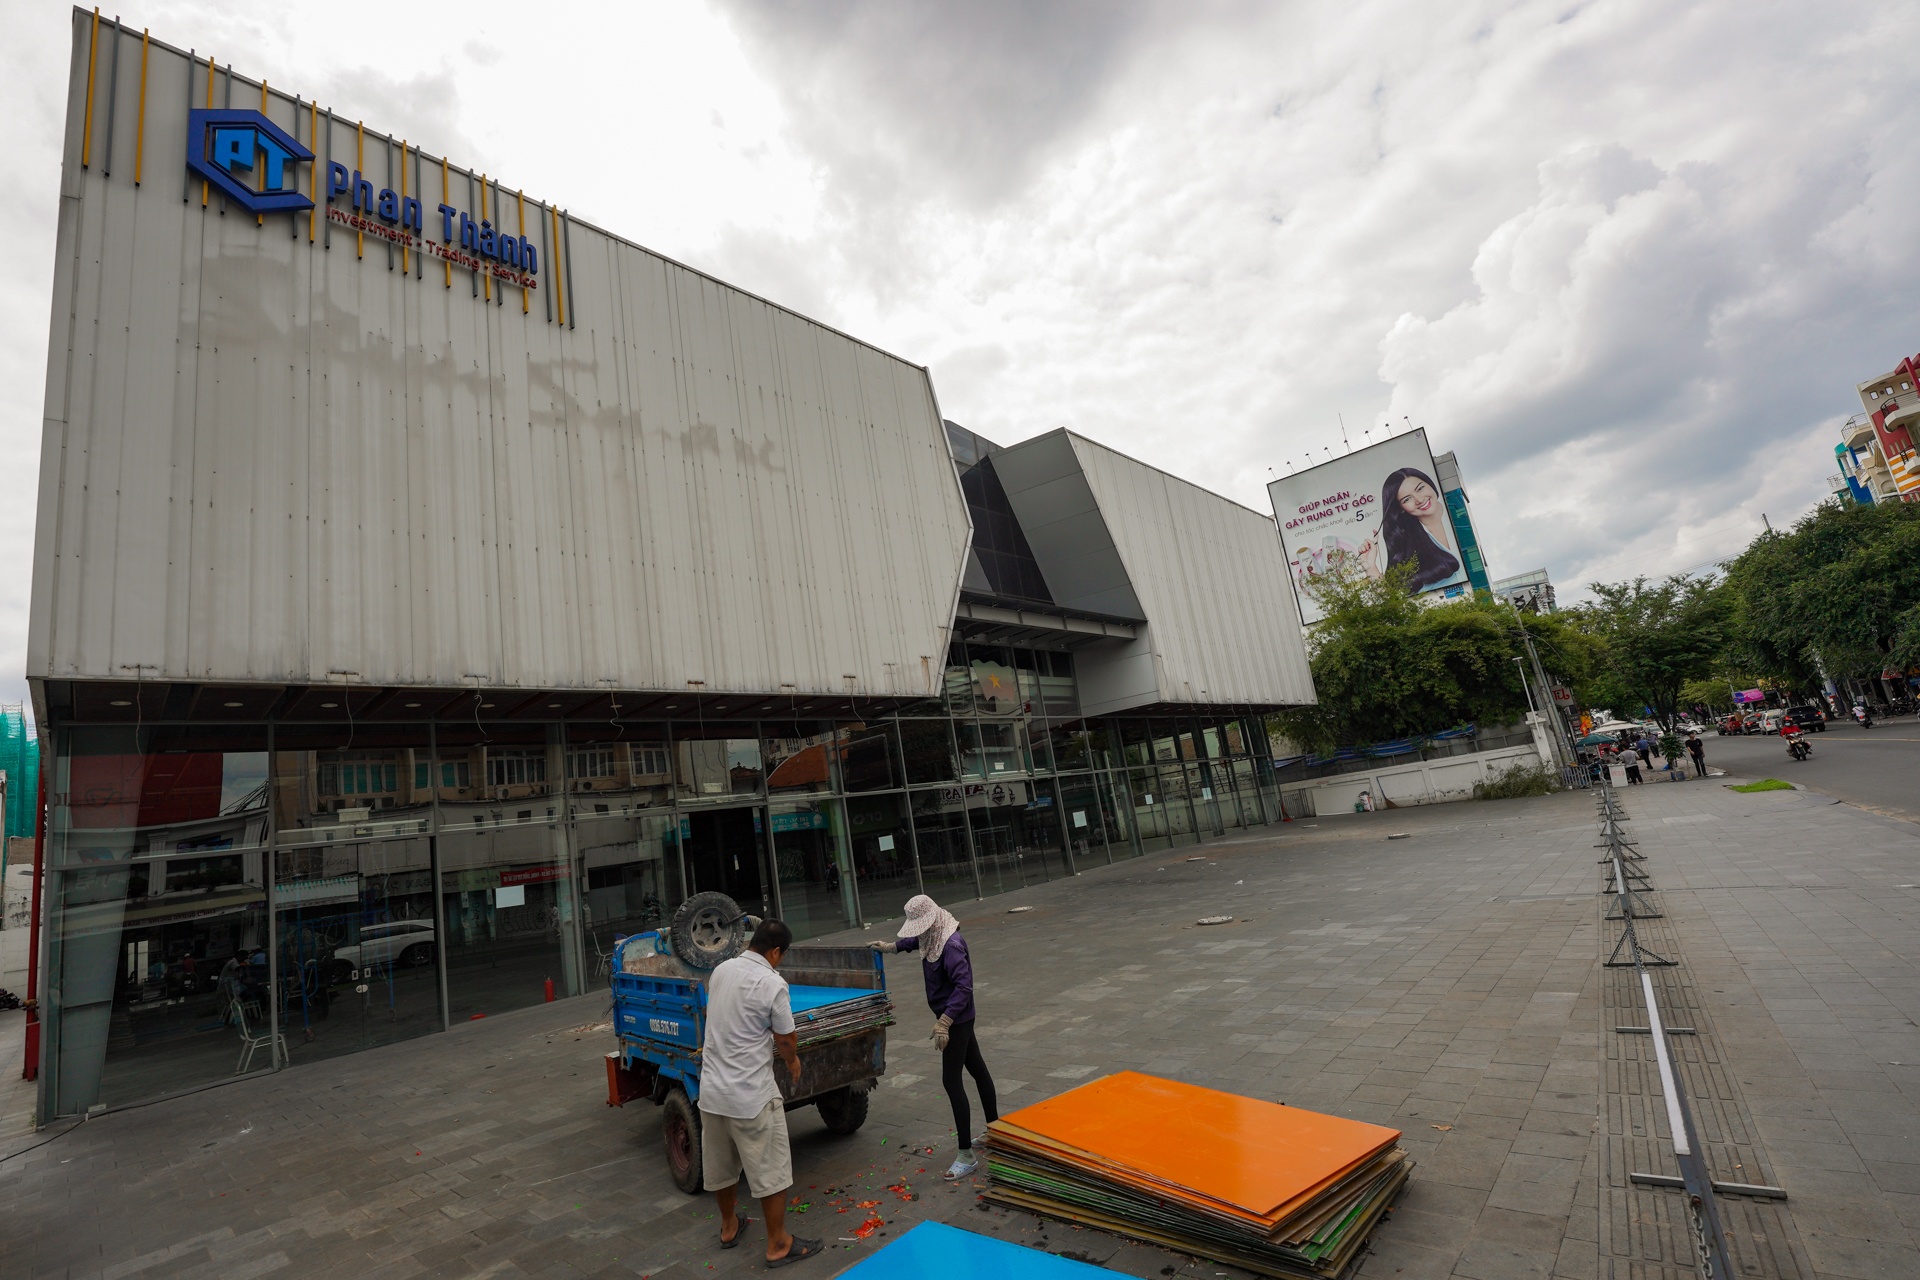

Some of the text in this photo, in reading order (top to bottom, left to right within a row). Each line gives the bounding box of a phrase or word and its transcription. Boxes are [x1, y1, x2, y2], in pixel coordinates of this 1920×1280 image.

[213, 128, 296, 191] PT
[327, 160, 539, 276] Phan Thành
[326, 205, 413, 246] Investment
[425, 239, 480, 273] Trading
[492, 263, 538, 290] Service
[1298, 491, 1350, 513] GIÚP NGĂN
[1307, 508, 1333, 522] RỤNG
[1335, 503, 1349, 513] TỪ
[1352, 495, 1374, 508] GỐC
[1355, 509, 1365, 522] 5
